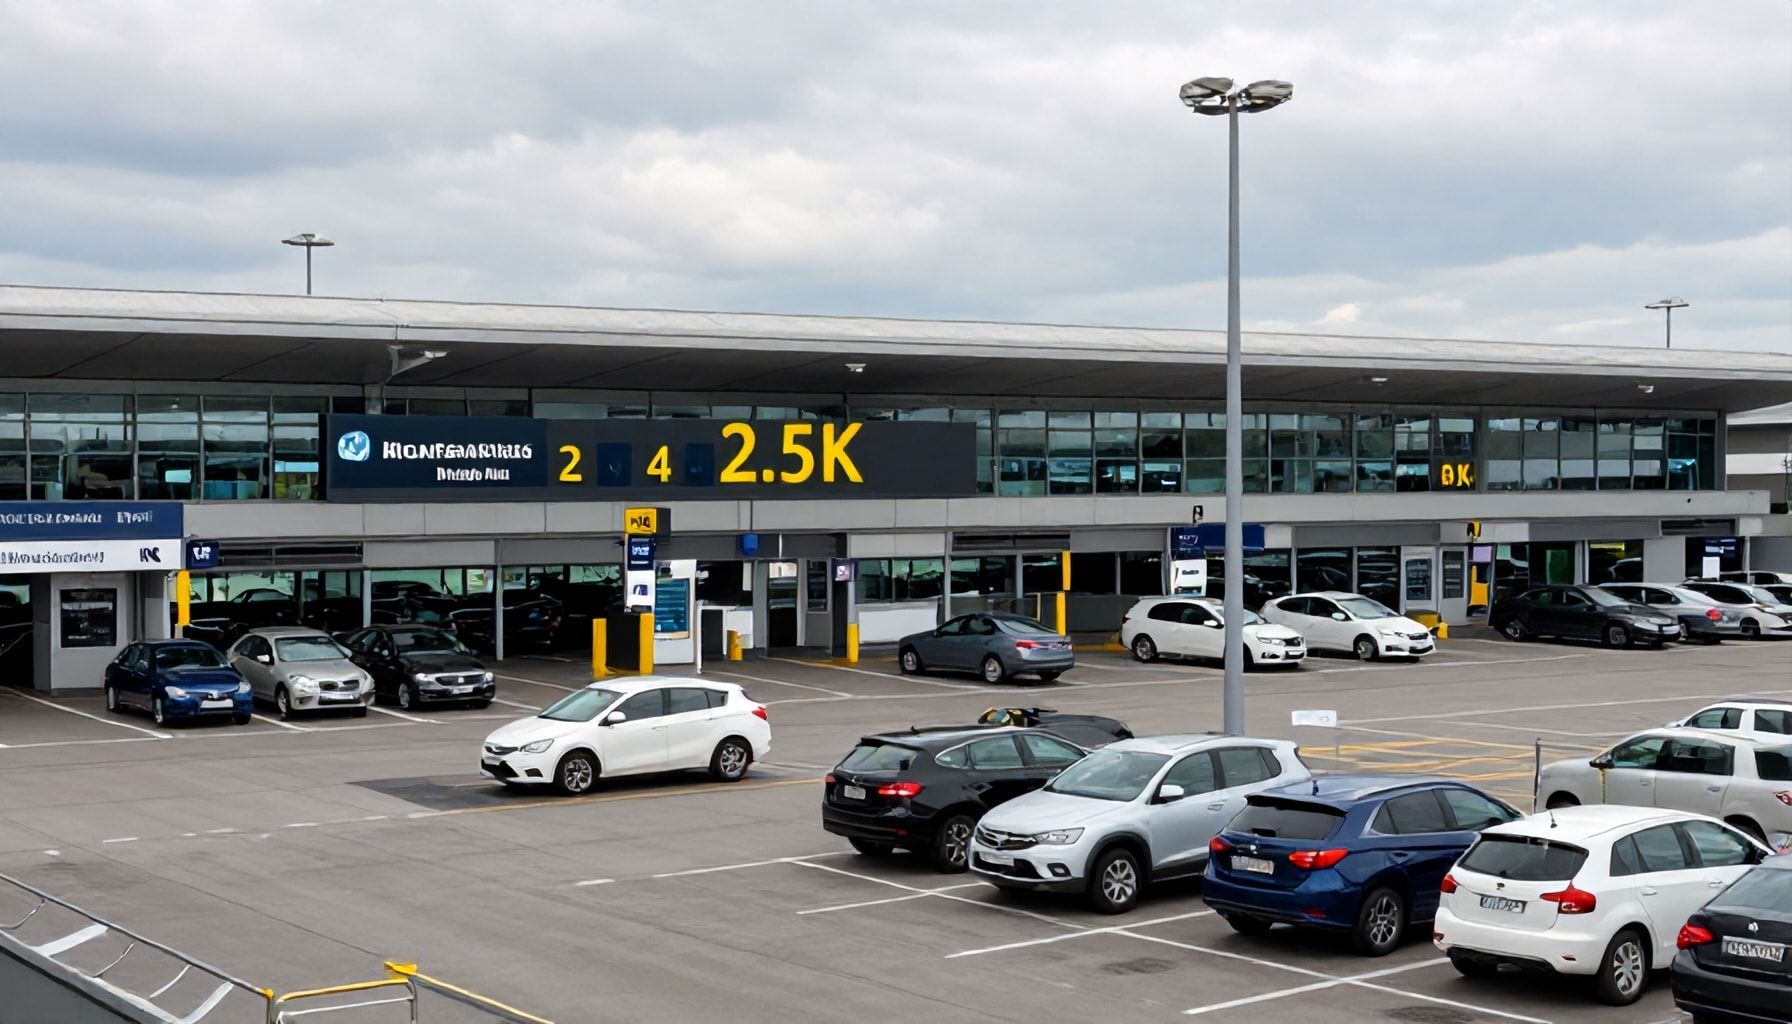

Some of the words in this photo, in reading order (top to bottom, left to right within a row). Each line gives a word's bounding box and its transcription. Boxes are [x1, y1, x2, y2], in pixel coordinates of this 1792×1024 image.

[559, 444, 582, 482] 2
[646, 445, 672, 482] 4
[720, 422, 864, 484] 2.5K
